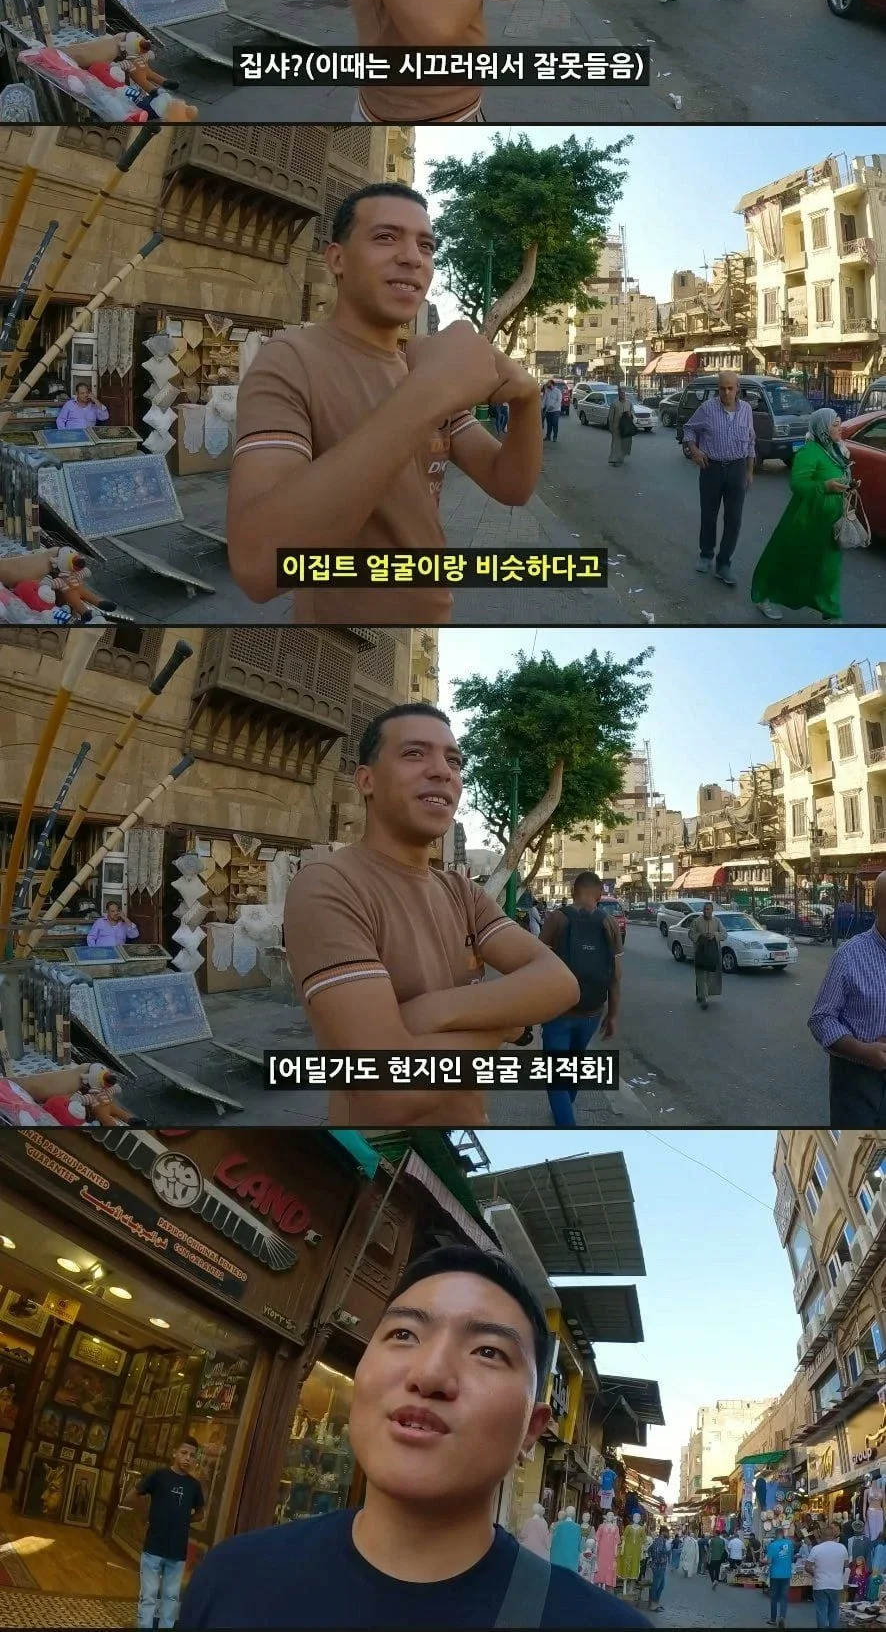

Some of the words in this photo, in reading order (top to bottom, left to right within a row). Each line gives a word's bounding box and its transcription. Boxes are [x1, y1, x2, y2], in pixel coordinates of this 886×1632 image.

[41, 1139, 79, 1168] PAPYRUS
[76, 1163, 110, 1190] PAINTED
[214, 1153, 311, 1234] LAND
